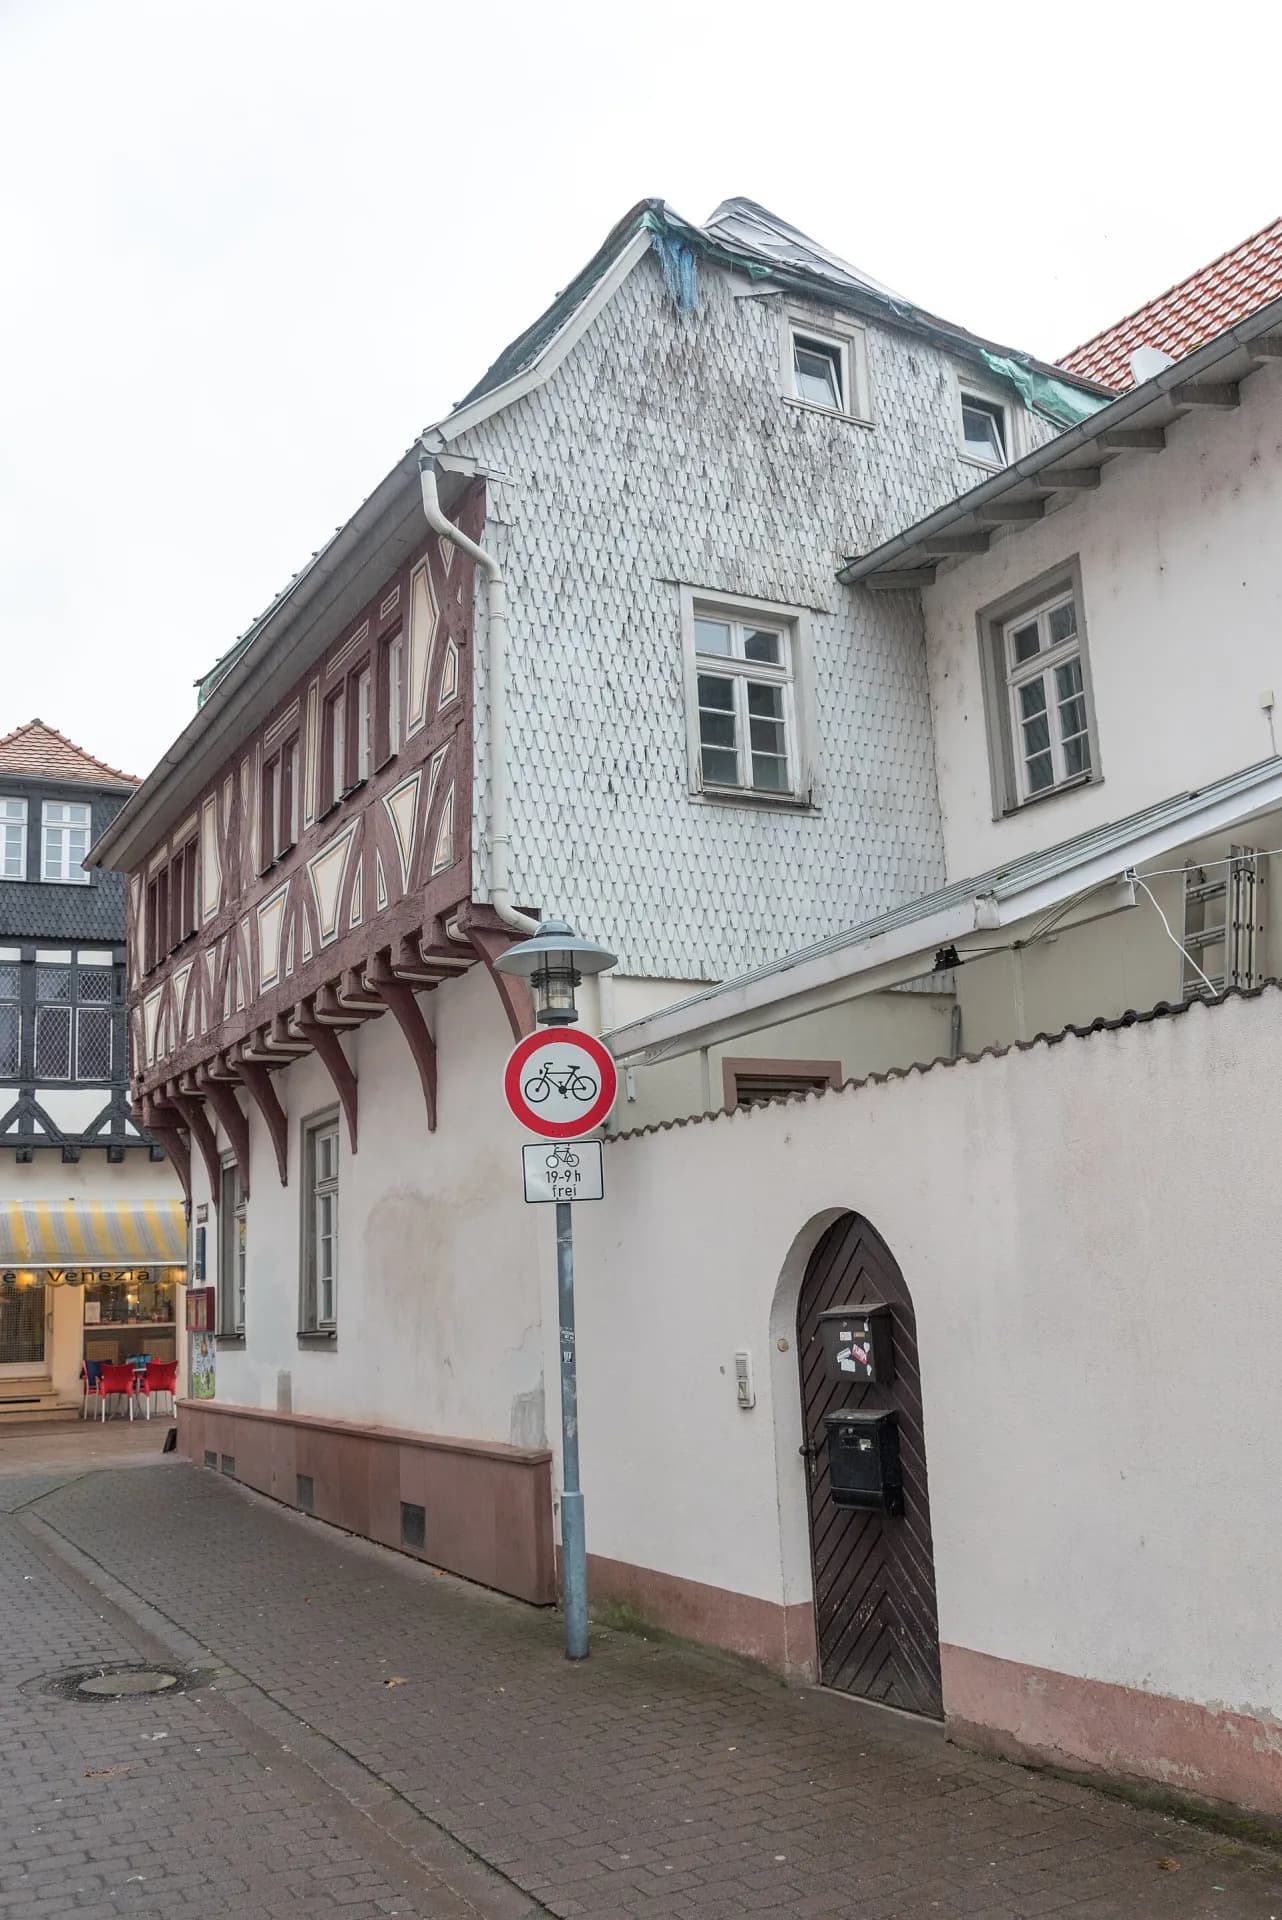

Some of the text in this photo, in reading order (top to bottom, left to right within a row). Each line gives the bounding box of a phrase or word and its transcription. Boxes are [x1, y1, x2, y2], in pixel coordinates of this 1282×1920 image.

[546, 1170, 581, 1183] 19-9 h
[552, 1184, 577, 1197] frei
[47, 1269, 150, 1282] Venezia
